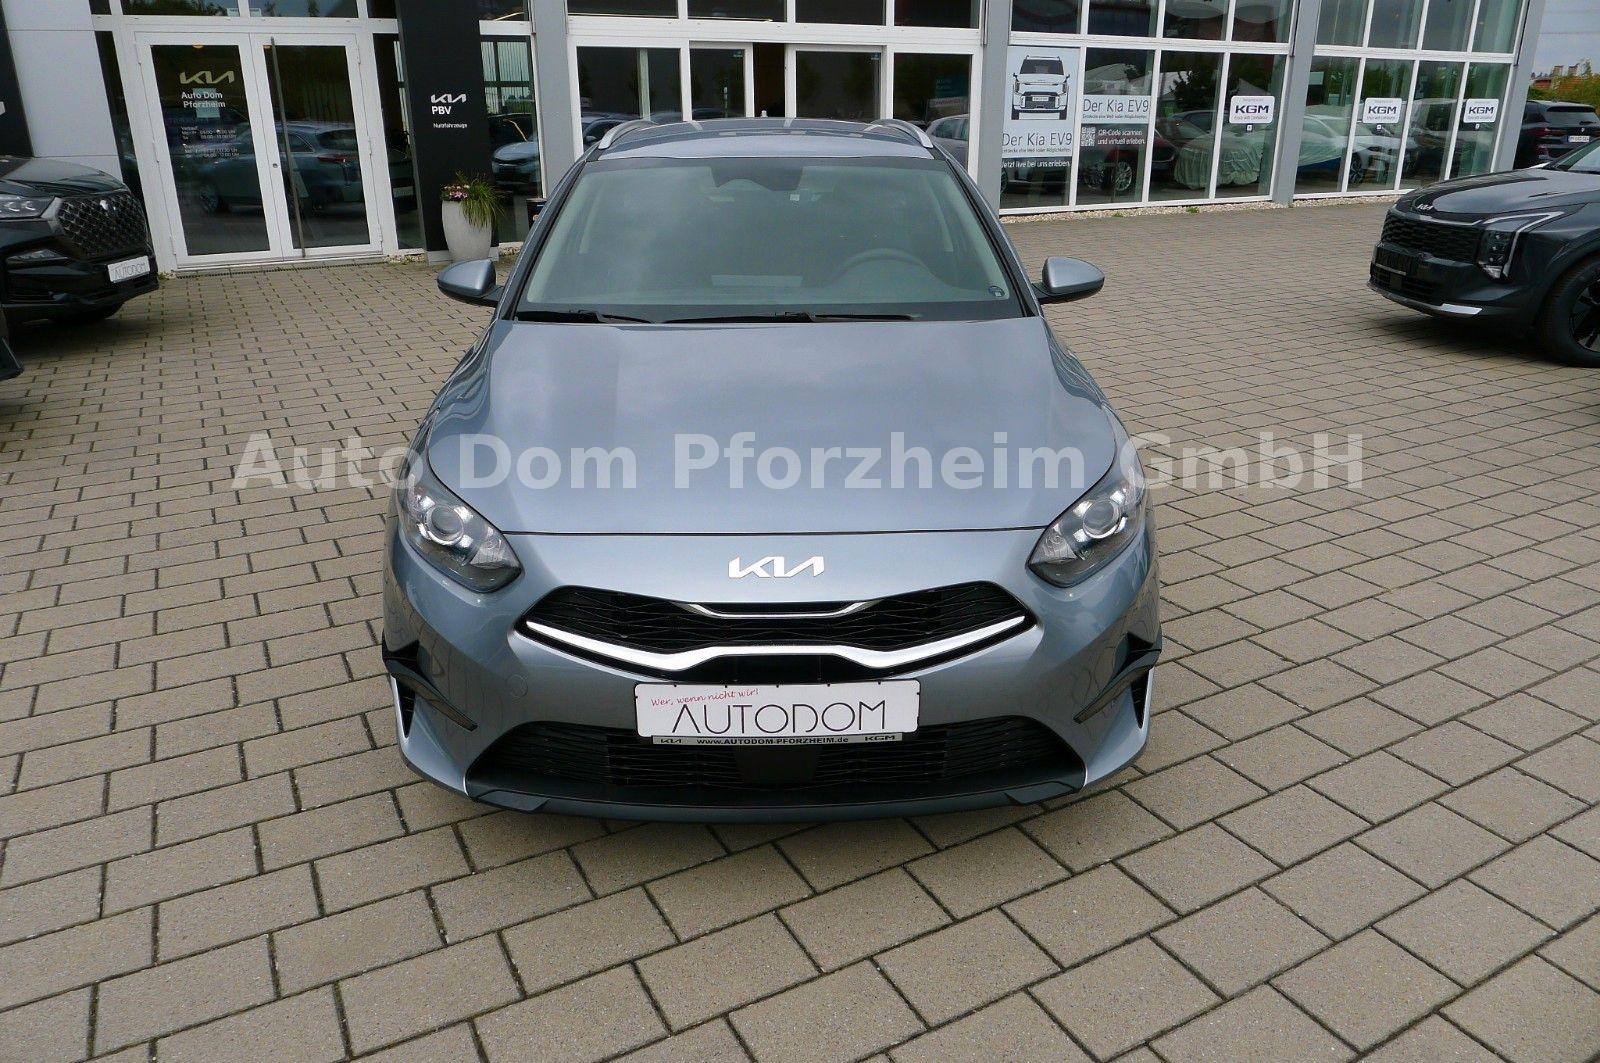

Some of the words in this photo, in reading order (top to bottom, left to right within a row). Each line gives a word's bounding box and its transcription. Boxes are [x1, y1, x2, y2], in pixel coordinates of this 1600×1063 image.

[179, 70, 235, 84] KIA
[181, 91, 202, 99] Auto
[203, 91, 223, 99] Dom
[430, 93, 467, 103] KIA
[183, 100, 226, 108] Pforzheim
[1083, 98, 1103, 112] Der
[1107, 98, 1124, 112] Kia
[1128, 99, 1149, 113] EV9
[1235, 104, 1270, 114] KGM
[431, 105, 452, 115] PBV
[1368, 105, 1397, 115] KGM
[1468, 106, 1495, 115] KGM
[1002, 132, 1023, 147] Der
[1027, 132, 1045, 146] Kia
[1050, 132, 1073, 146] EV9
[1016, 160, 1027, 168] live
[1027, 160, 1037, 168] bei
[728, 556, 825, 578] KIA
[651, 697, 674, 707] Wer,
[677, 695, 706, 704] wenn
[708, 690, 735, 701] nicht
[738, 688, 759, 697] wir!
[672, 700, 886, 734] AUTODOM
[696, 736, 849, 745] www.AUTODOM-PFORZHEIM.de
[864, 734, 896, 742] KGM
